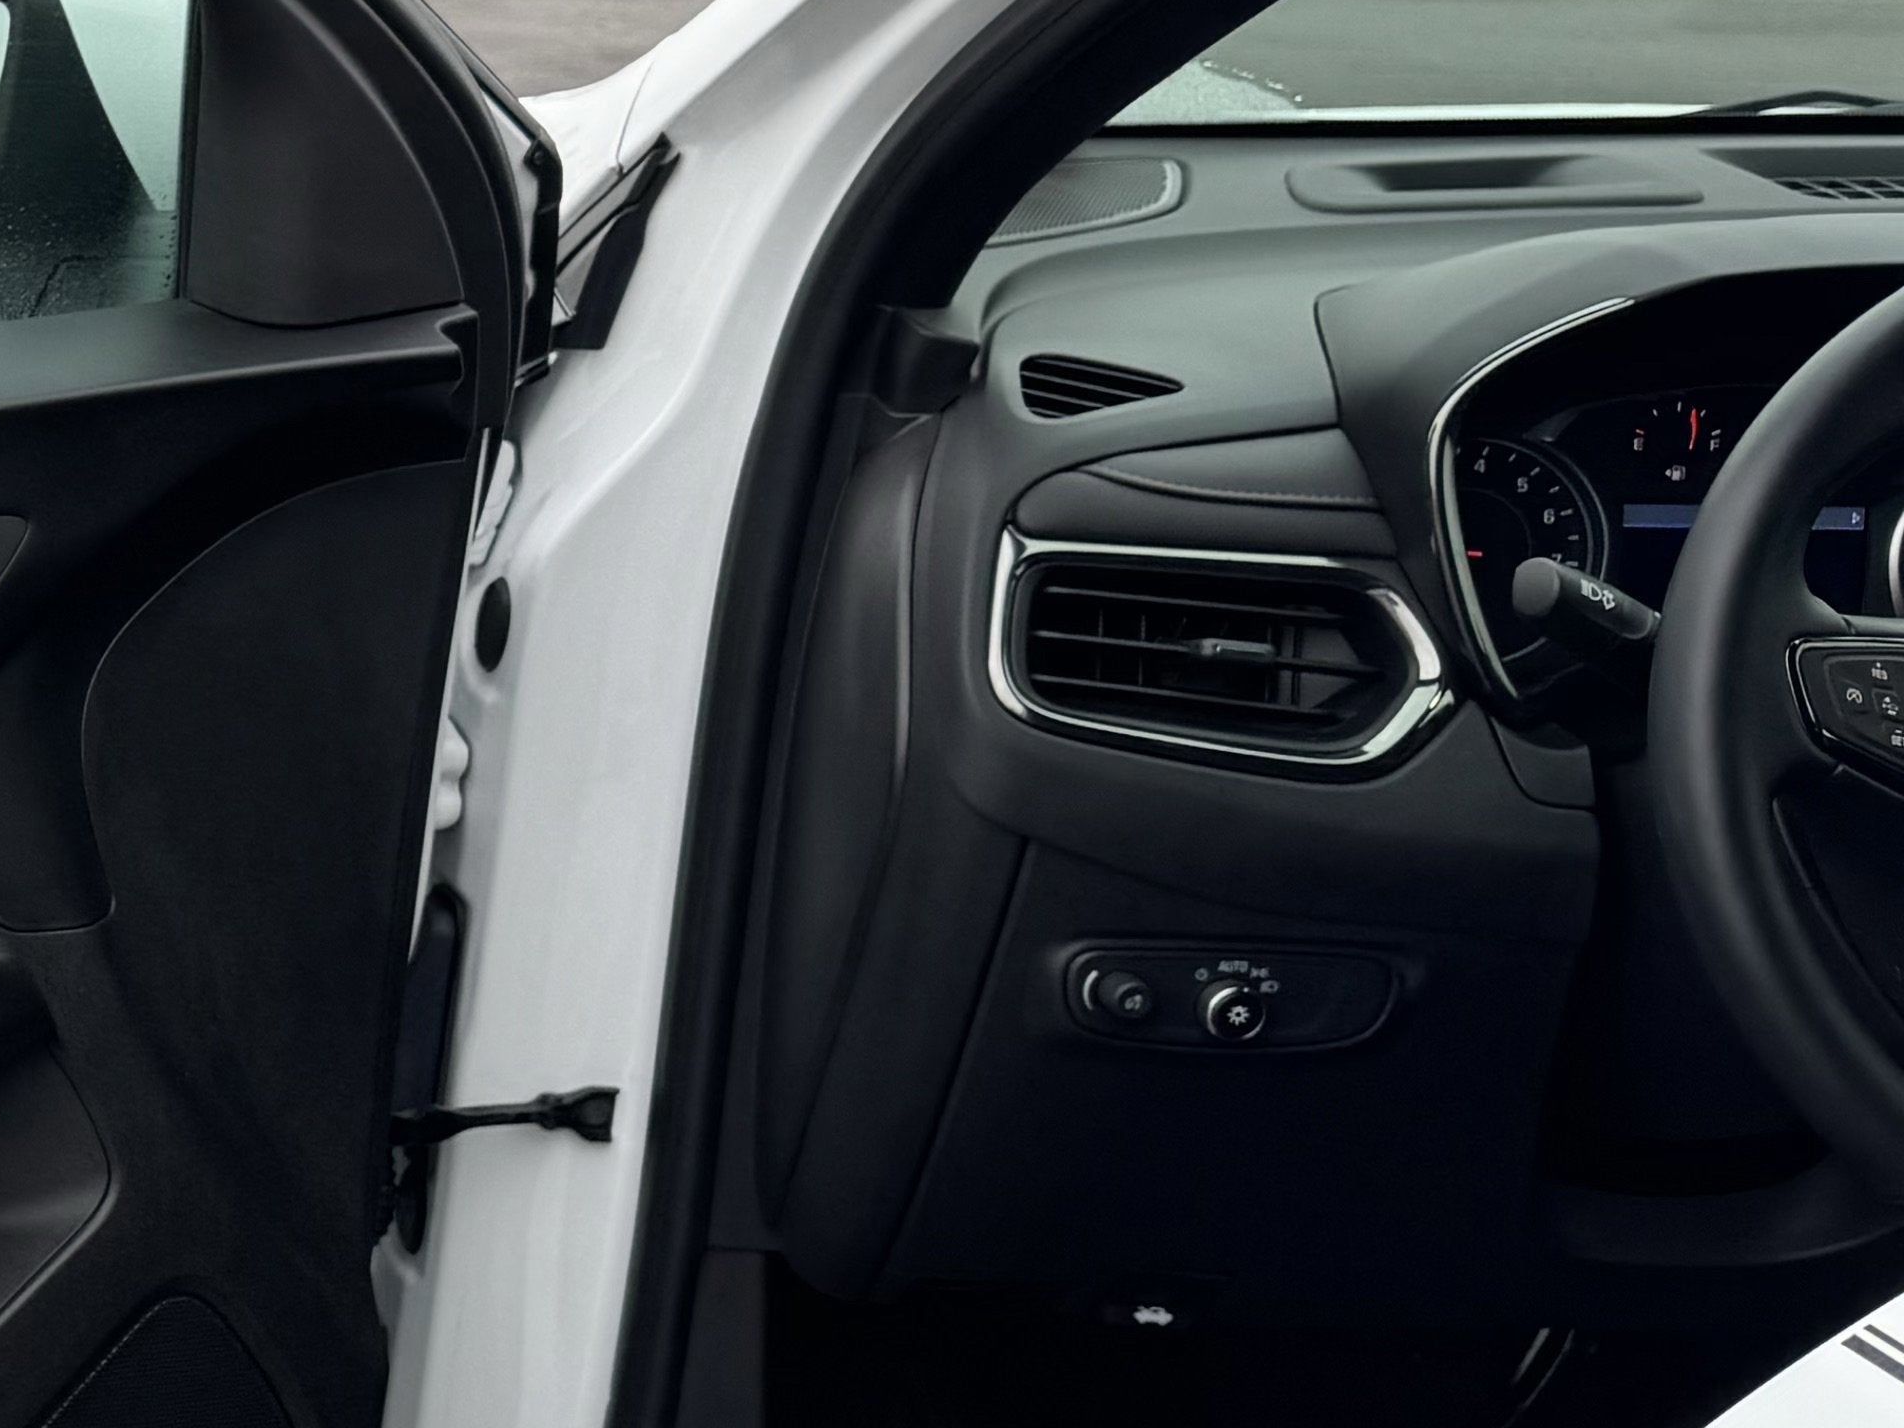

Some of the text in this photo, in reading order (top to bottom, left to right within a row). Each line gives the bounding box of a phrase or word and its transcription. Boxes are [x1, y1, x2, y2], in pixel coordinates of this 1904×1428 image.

[1473, 458, 1486, 474] 4
[1516, 476, 1529, 493] 5
[1543, 508, 1556, 525] 6
